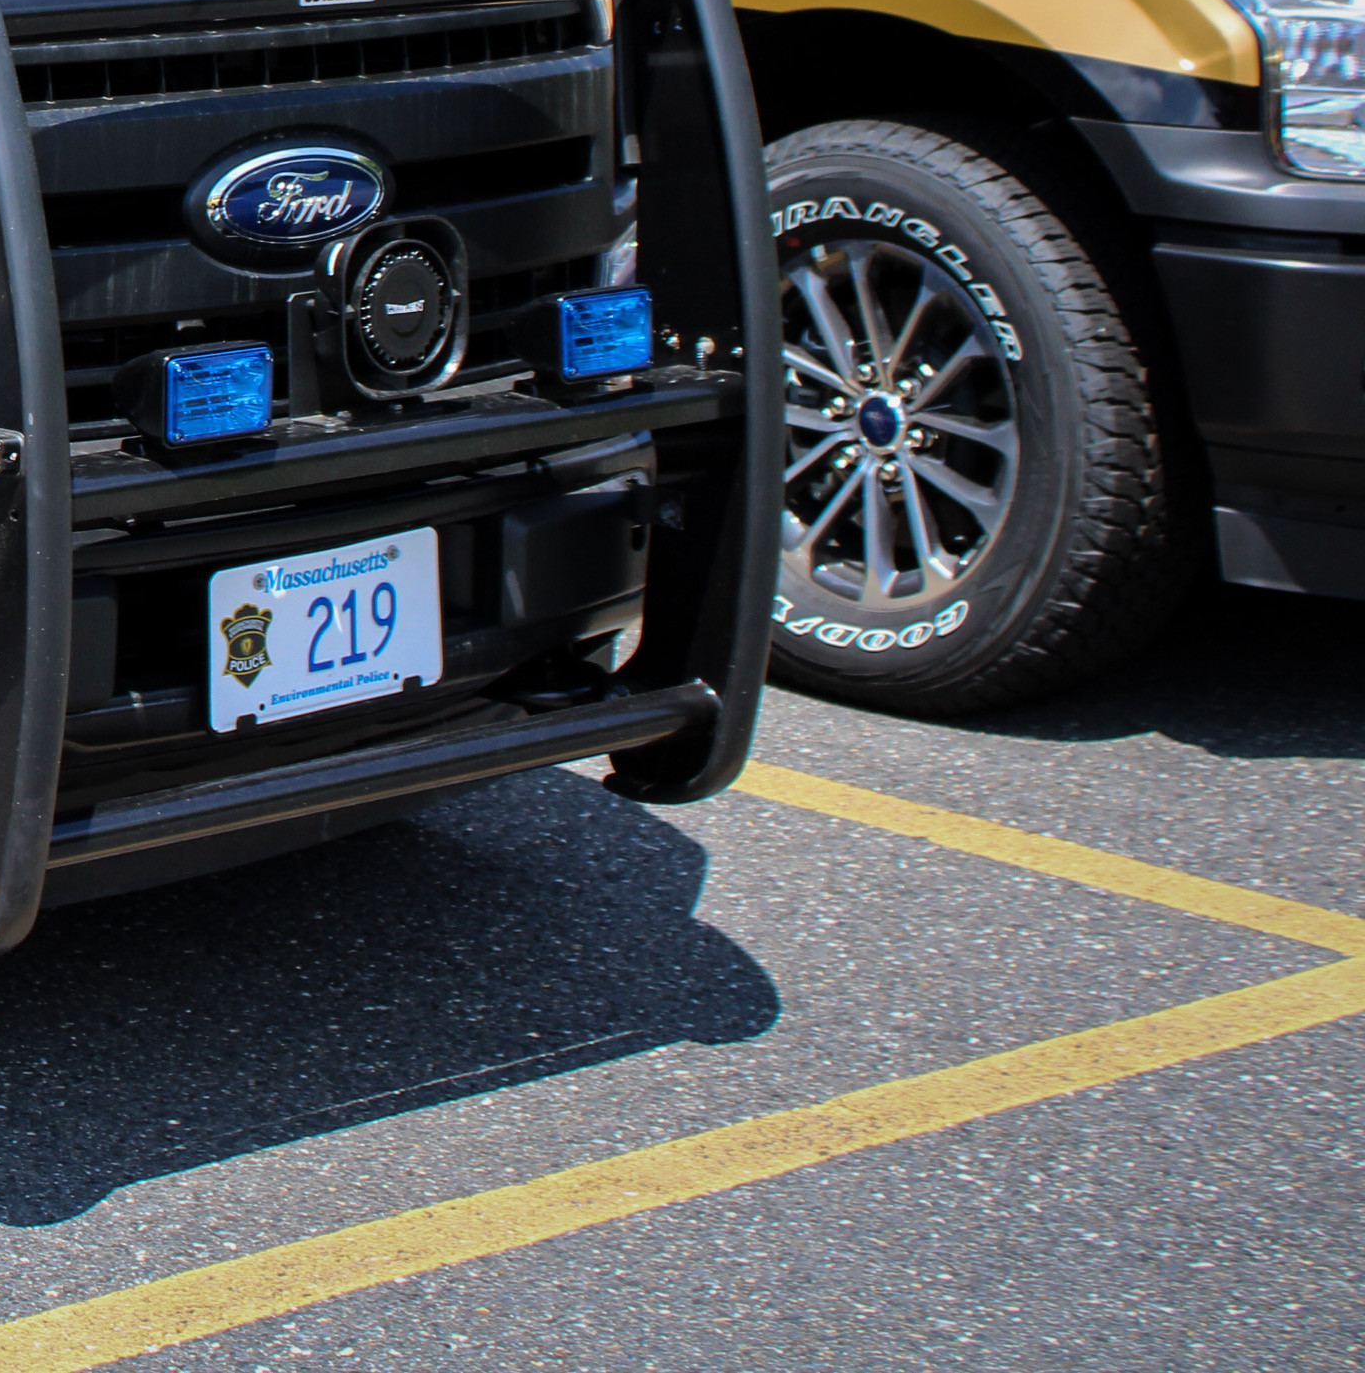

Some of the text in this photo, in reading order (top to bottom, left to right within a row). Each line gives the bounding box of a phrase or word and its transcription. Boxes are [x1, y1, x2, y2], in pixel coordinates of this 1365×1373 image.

[258, 170, 354, 225] Ford
[264, 549, 390, 594] Massachusetts
[306, 581, 397, 673] 219
[229, 653, 267, 672] POLICE
[269, 670, 390, 706] Environmental Police
